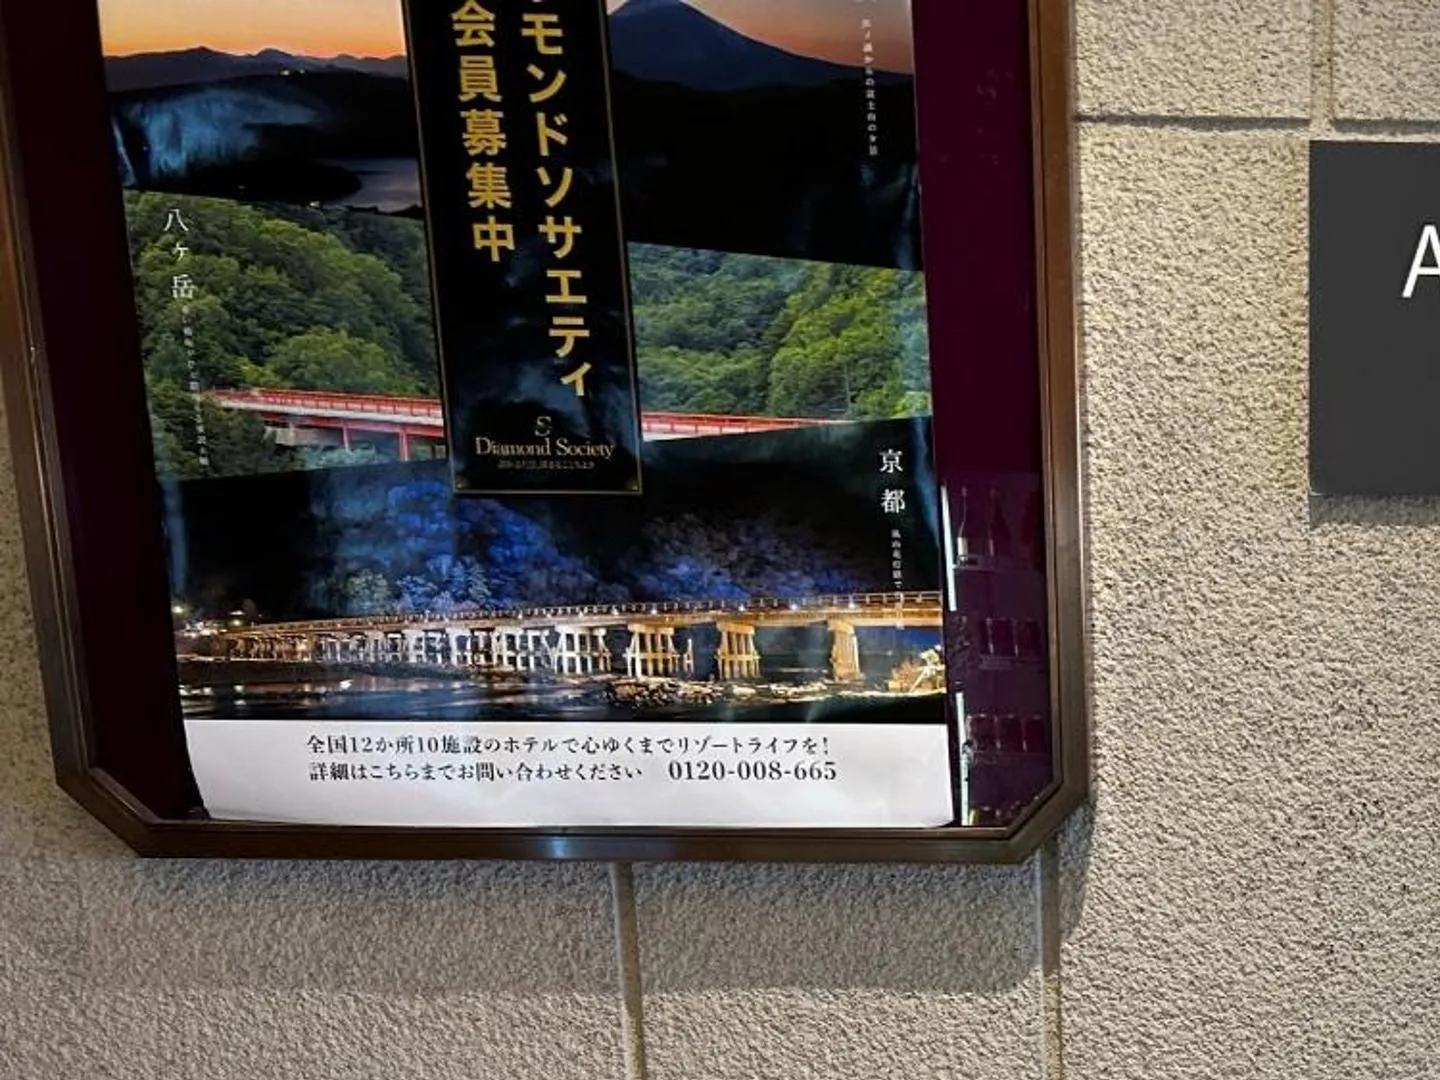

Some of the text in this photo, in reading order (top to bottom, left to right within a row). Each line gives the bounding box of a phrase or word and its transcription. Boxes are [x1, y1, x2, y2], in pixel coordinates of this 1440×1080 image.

[451, 0, 516, 263] 会員募集中
[521, 0, 592, 396] モンドソサエティ
[475, 436, 615, 461] Diamond Society
[878, 448, 906, 514] 京都
[308, 760, 838, 783] 詳細はこちらまでお問い合わせください 0120-008-665
